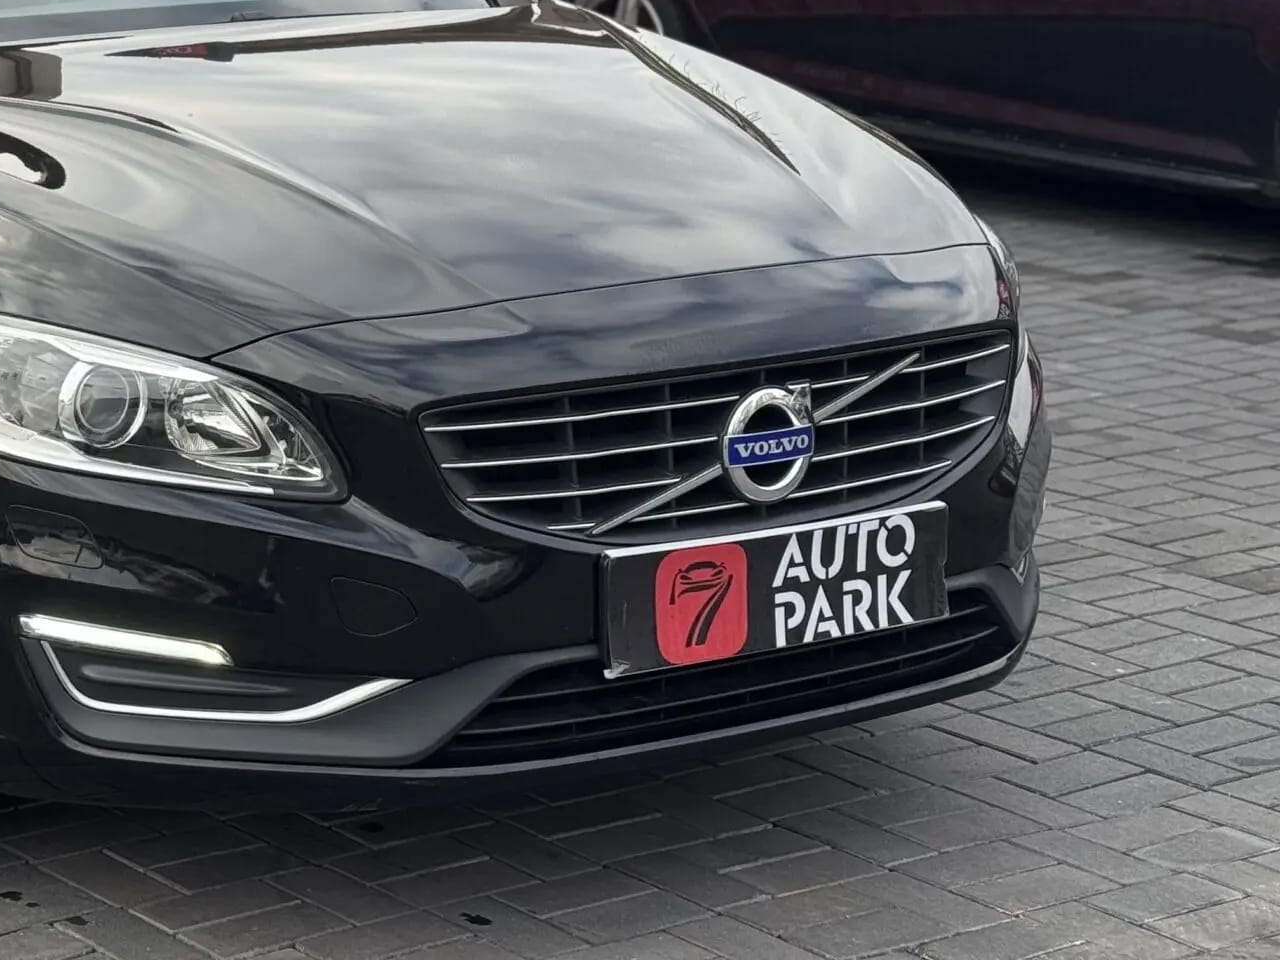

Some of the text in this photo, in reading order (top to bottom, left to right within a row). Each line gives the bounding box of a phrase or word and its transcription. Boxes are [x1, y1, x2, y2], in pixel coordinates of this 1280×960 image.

[733, 432, 811, 460] VOLVO
[772, 514, 916, 588] AUTO
[774, 569, 915, 648] PARK
